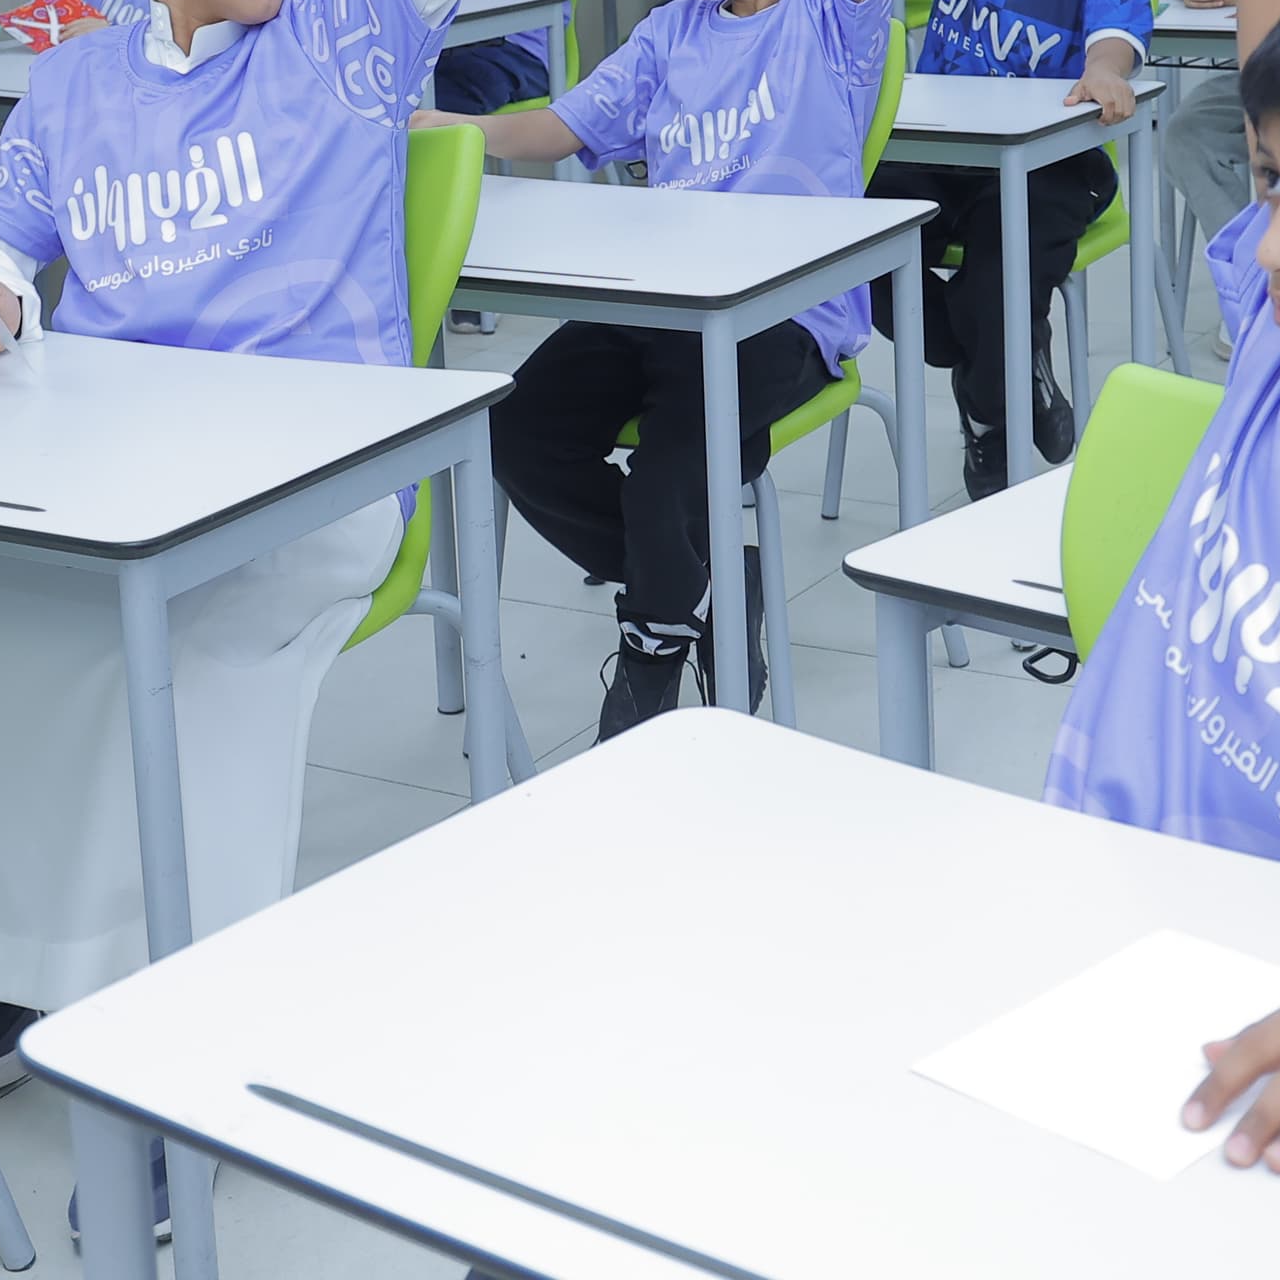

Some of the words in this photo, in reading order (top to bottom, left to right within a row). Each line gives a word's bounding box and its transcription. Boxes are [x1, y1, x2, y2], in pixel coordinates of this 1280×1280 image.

[931, 17, 985, 58] GAMES
[67, 131, 264, 252] القيروان
[139, 243, 221, 279] القيروان
[226, 228, 273, 260] نادي
[85, 258, 137, 293] الموسم
